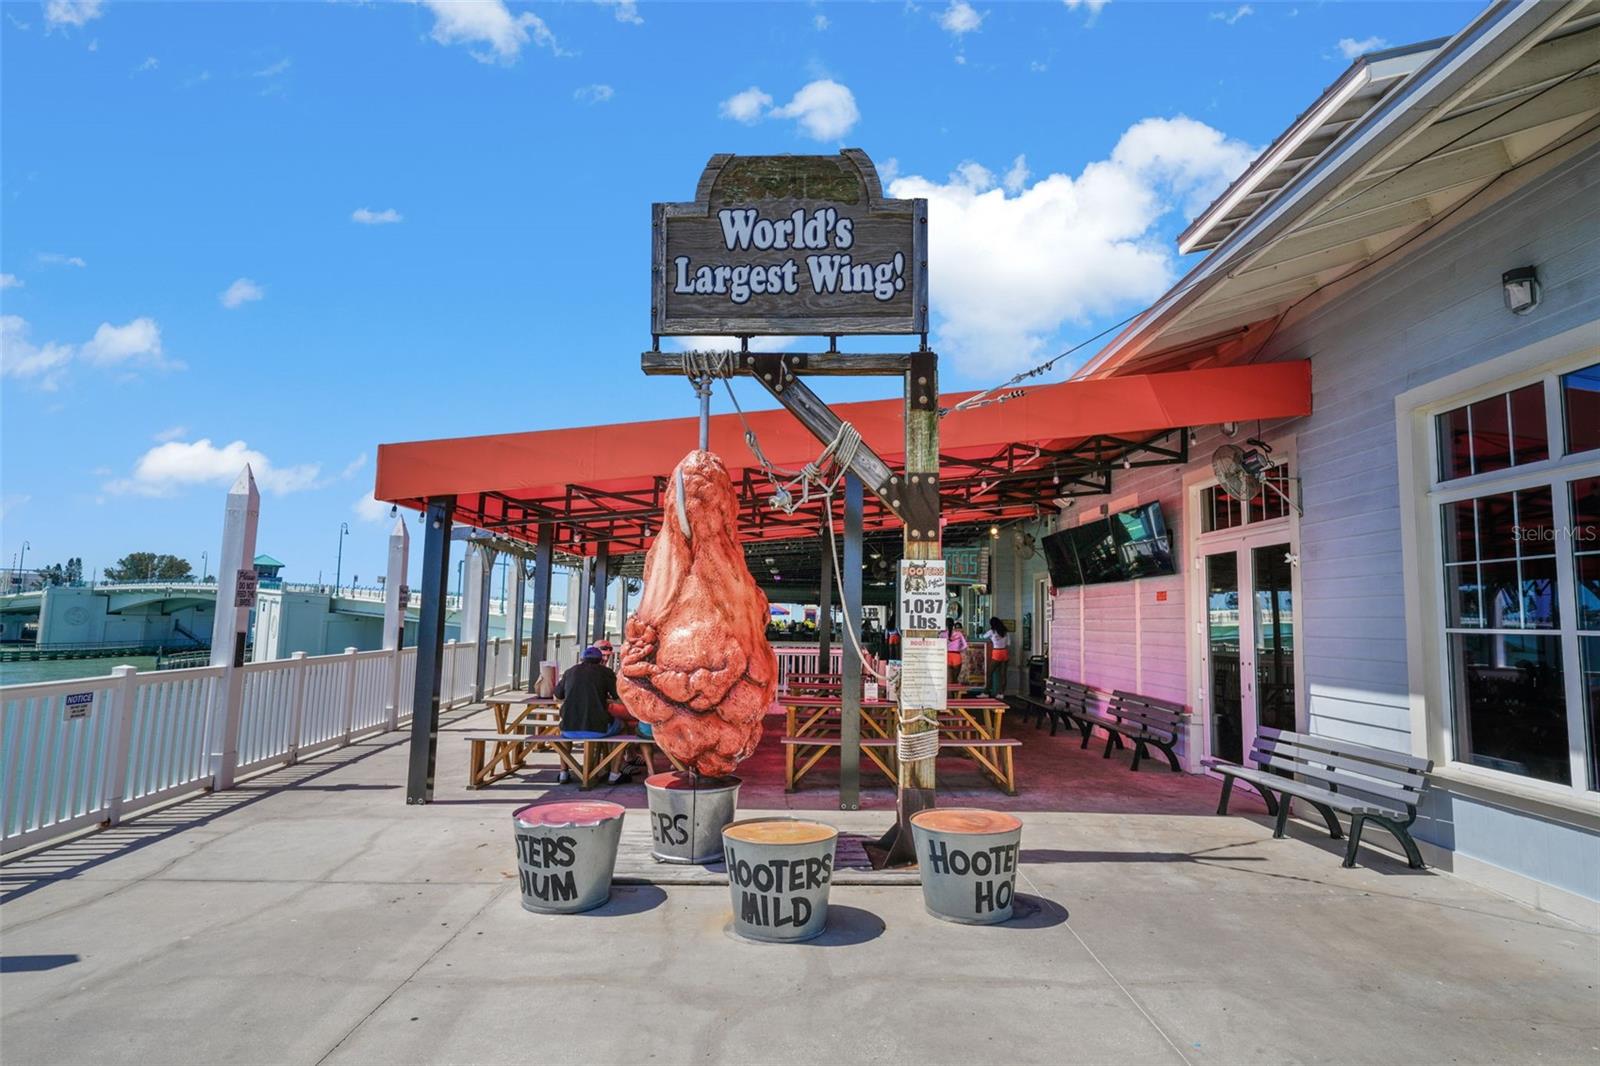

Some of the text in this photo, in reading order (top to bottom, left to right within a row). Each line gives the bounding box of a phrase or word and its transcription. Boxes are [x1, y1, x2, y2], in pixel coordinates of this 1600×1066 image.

[718, 207, 854, 250] World's
[674, 251, 905, 303] Largest Wing!
[902, 599, 943, 615] 1,037
[909, 615, 941, 630] Lbs.
[67, 694, 91, 703] NOTICE
[725, 847, 832, 893] HOOTERS
[741, 891, 812, 928] MILD
